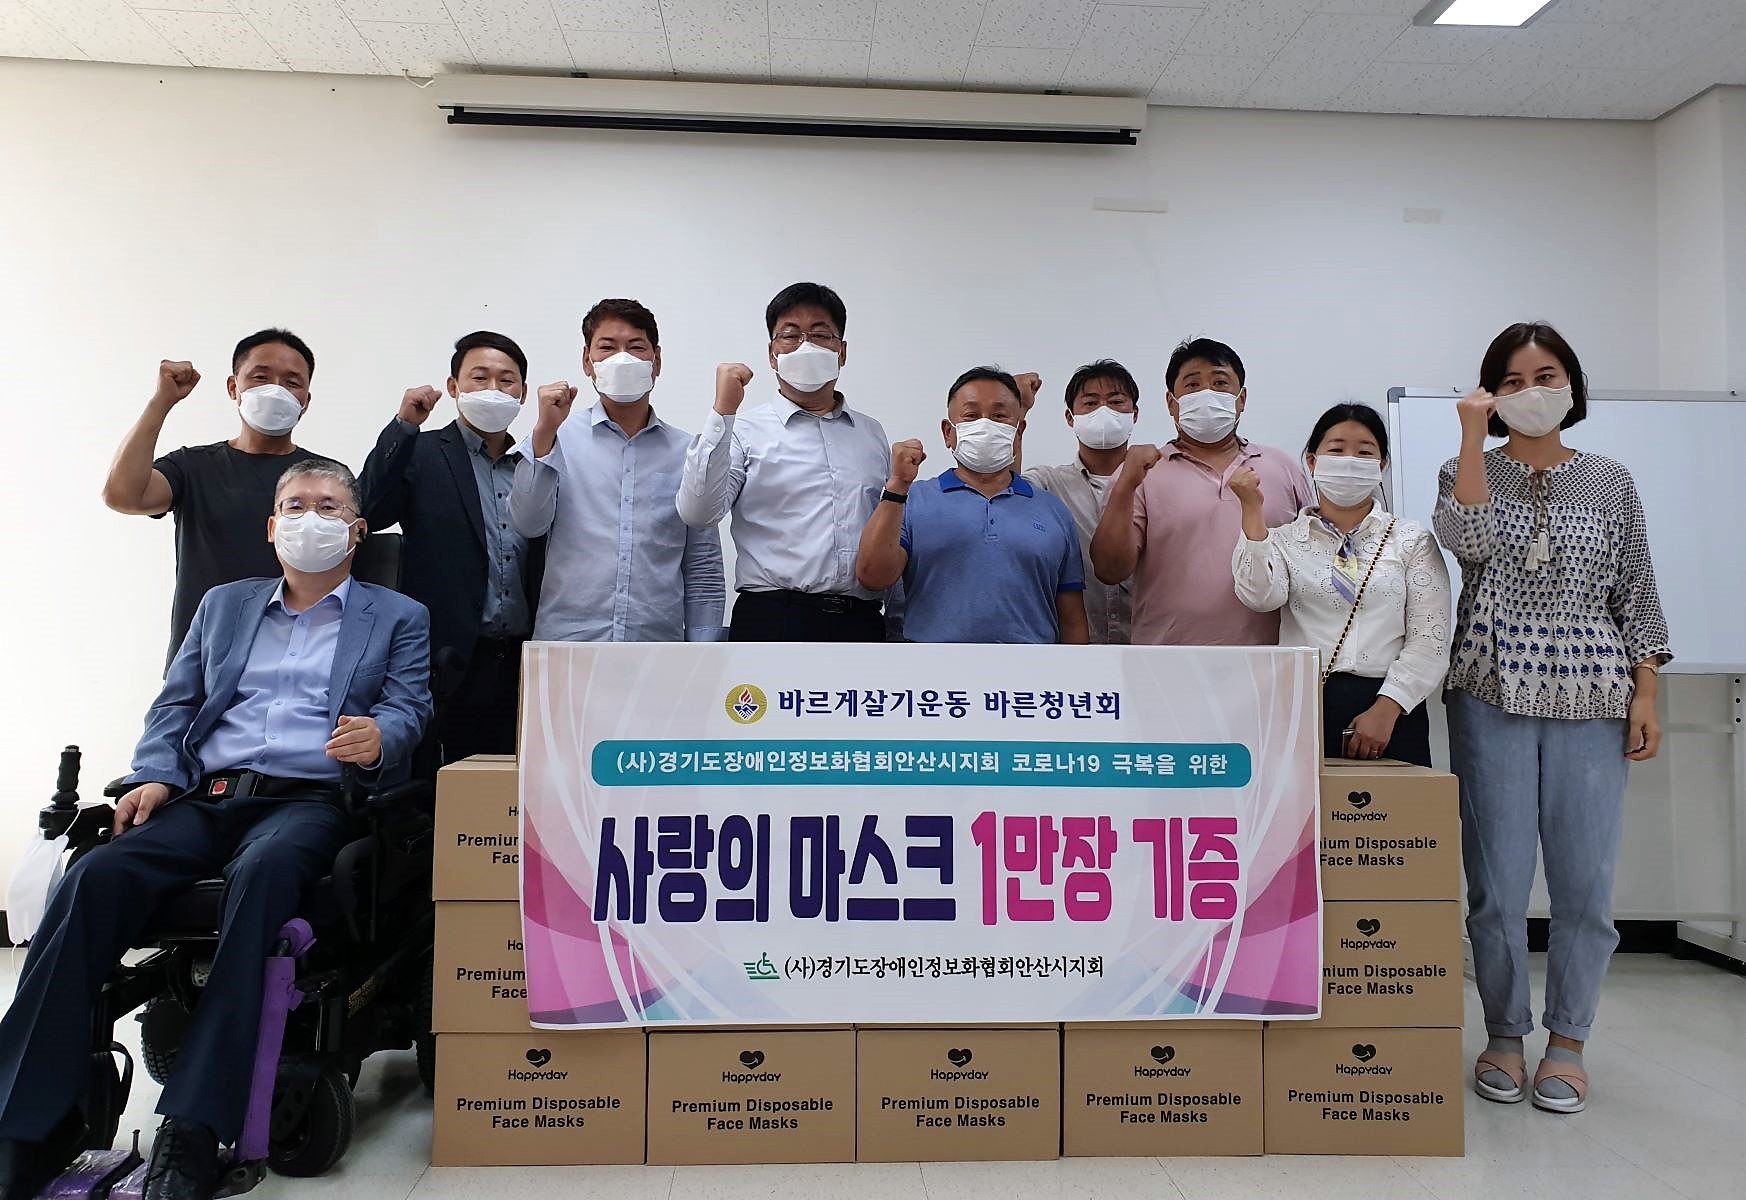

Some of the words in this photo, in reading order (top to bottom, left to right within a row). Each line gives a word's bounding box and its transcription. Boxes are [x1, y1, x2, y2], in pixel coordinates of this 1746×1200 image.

[777, 688, 971, 719] 바르게살기운동
[983, 690, 1120, 721] 바른청년회
[616, 750, 999, 775] (사)경기도장애인정보화협회안산시지회
[1012, 753, 1100, 775] 코로나19
[1112, 754, 1176, 776] 극복을
[1188, 754, 1228, 776] 위한
[1331, 810, 1388, 823] Happyday
[1355, 836, 1438, 851] Disposable
[492, 851, 519, 864] Fac
[1320, 853, 1353, 866] Face
[1358, 853, 1405, 866] Masks
[593, 813, 771, 924] 사랑의
[789, 814, 957, 922] 마스크
[971, 811, 1118, 925] 1만장
[1132, 817, 1240, 922] 기증
[1340, 938, 1397, 951] Happyday
[456, 967, 526, 981] Premium
[783, 955, 1104, 980] (사)경기도장애인정보화협회안산시지회
[1322, 964, 1359, 978] mium
[1364, 964, 1447, 979] Disposable
[491, 985, 528, 999] Face
[1327, 981, 1362, 995] Face
[1366, 981, 1414, 995] Masks
[508, 1070, 568, 1082] Happyday
[722, 1071, 781, 1084] Happyday
[931, 1069, 988, 1082] Happyday
[1134, 1065, 1192, 1079] Happyday
[1335, 1063, 1393, 1077] Happyday
[456, 1097, 527, 1111] Premium
[532, 1096, 621, 1111] Disposable
[881, 1096, 949, 1110] Premium
[954, 1095, 1040, 1110] Disposable
[1086, 1093, 1153, 1107] Premium
[1157, 1092, 1242, 1107] Disposable
[1288, 1089, 1354, 1104] Premium
[1359, 1090, 1444, 1105] Disposable
[672, 1099, 741, 1113] Premium
[746, 1098, 834, 1113] Disposable
[492, 1115, 529, 1129] Face
[534, 1114, 585, 1128] Masks
[916, 1114, 953, 1128] Face
[957, 1113, 1006, 1127] Masks
[1120, 1110, 1156, 1124] Face
[1160, 1109, 1208, 1123] Masks
[1322, 1107, 1358, 1121] Face
[1362, 1107, 1410, 1122] Masks
[707, 1117, 744, 1131] Face
[748, 1115, 799, 1130] Masks
